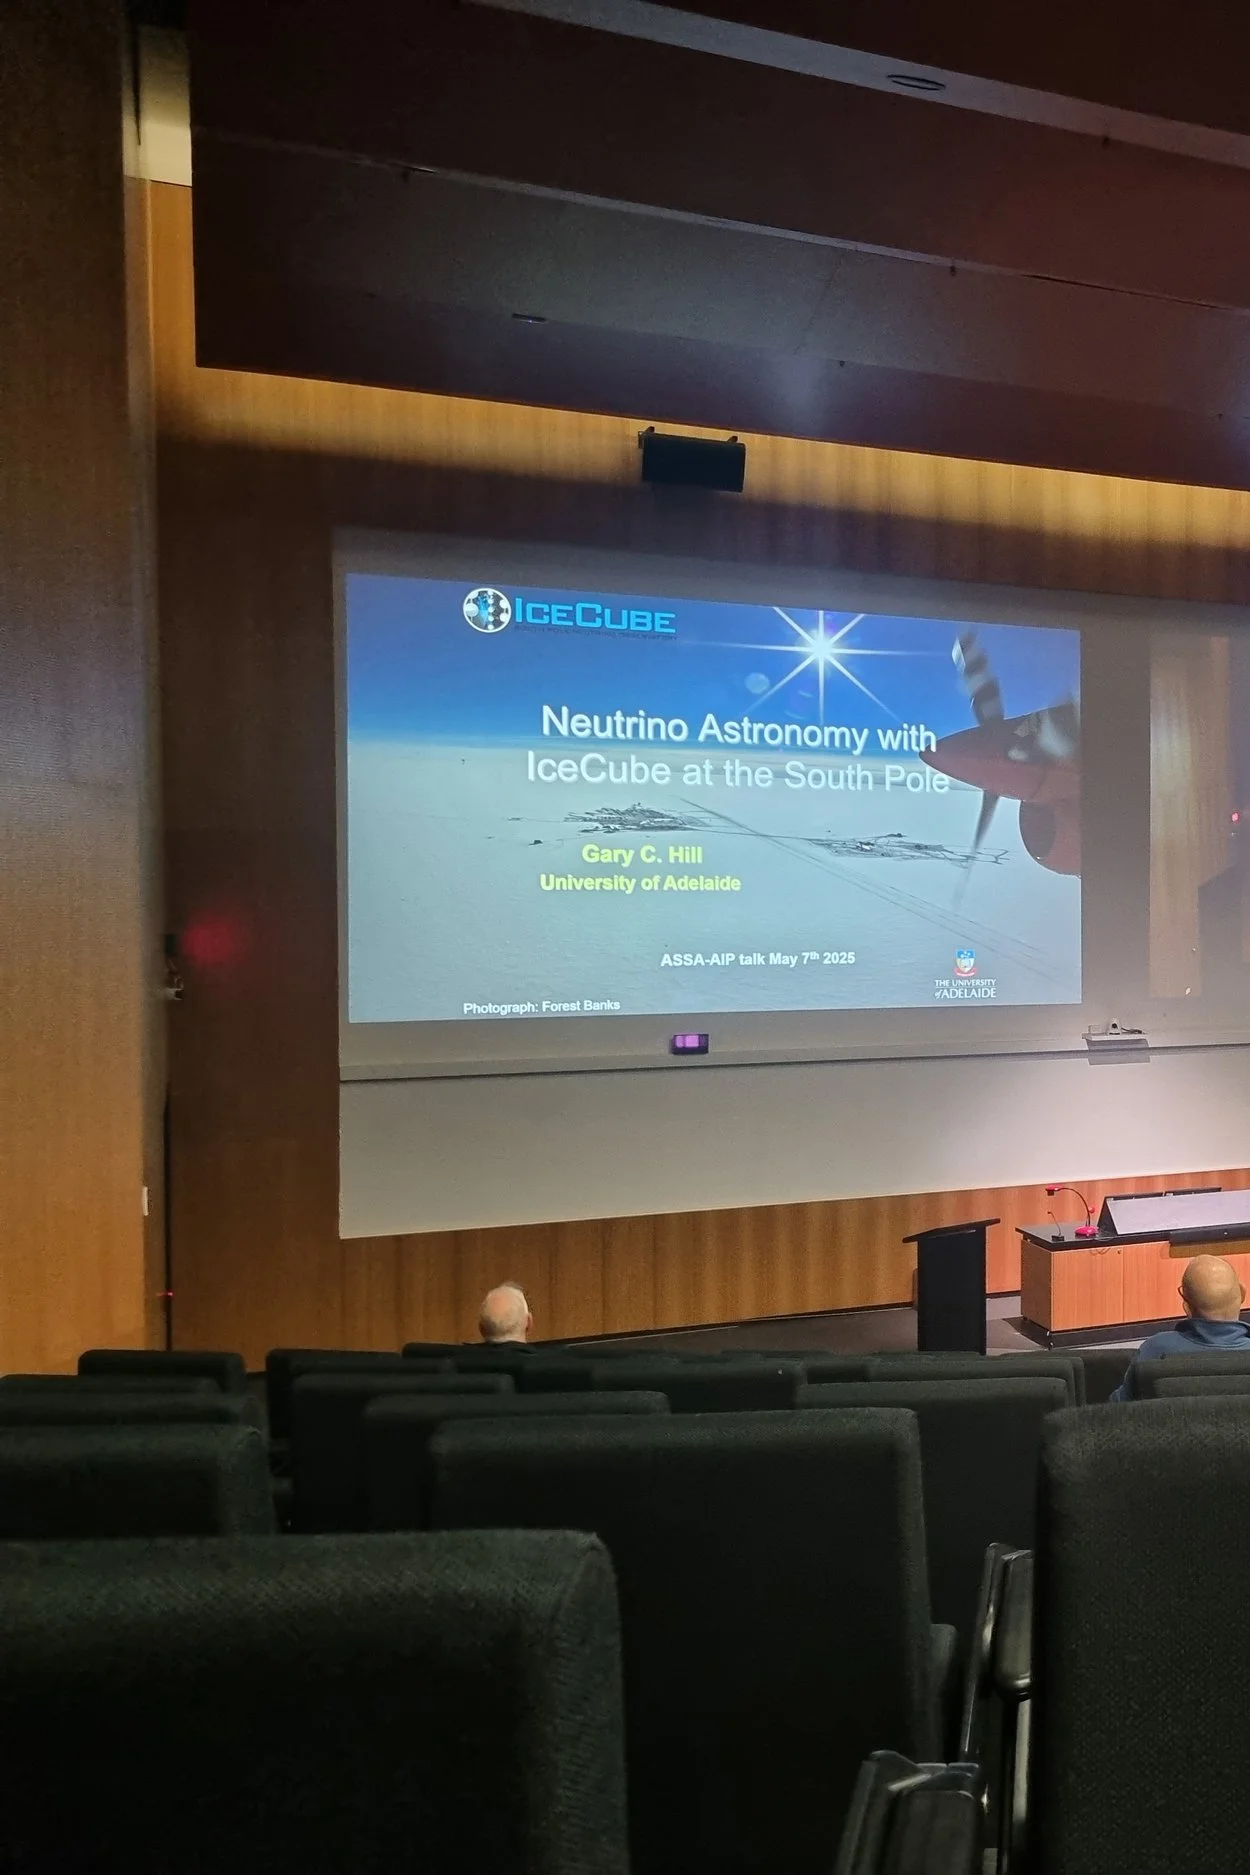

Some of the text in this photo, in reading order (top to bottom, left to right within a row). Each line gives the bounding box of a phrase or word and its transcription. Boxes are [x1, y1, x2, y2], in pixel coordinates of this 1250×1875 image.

[542, 704, 937, 756] Neutrino Astronomy with
[527, 750, 950, 793] IceCube at the South Pole
[581, 843, 703, 868] Gary C. Hill
[539, 873, 742, 895] University of Adelaide
[660, 951, 856, 968] ASSA-AIP talk May 7th 2025
[934, 978, 997, 987] THE UNIVERSITY
[941, 987, 997, 999] ADELAIDE
[463, 999, 621, 1016] Photograph: Forest Banks
